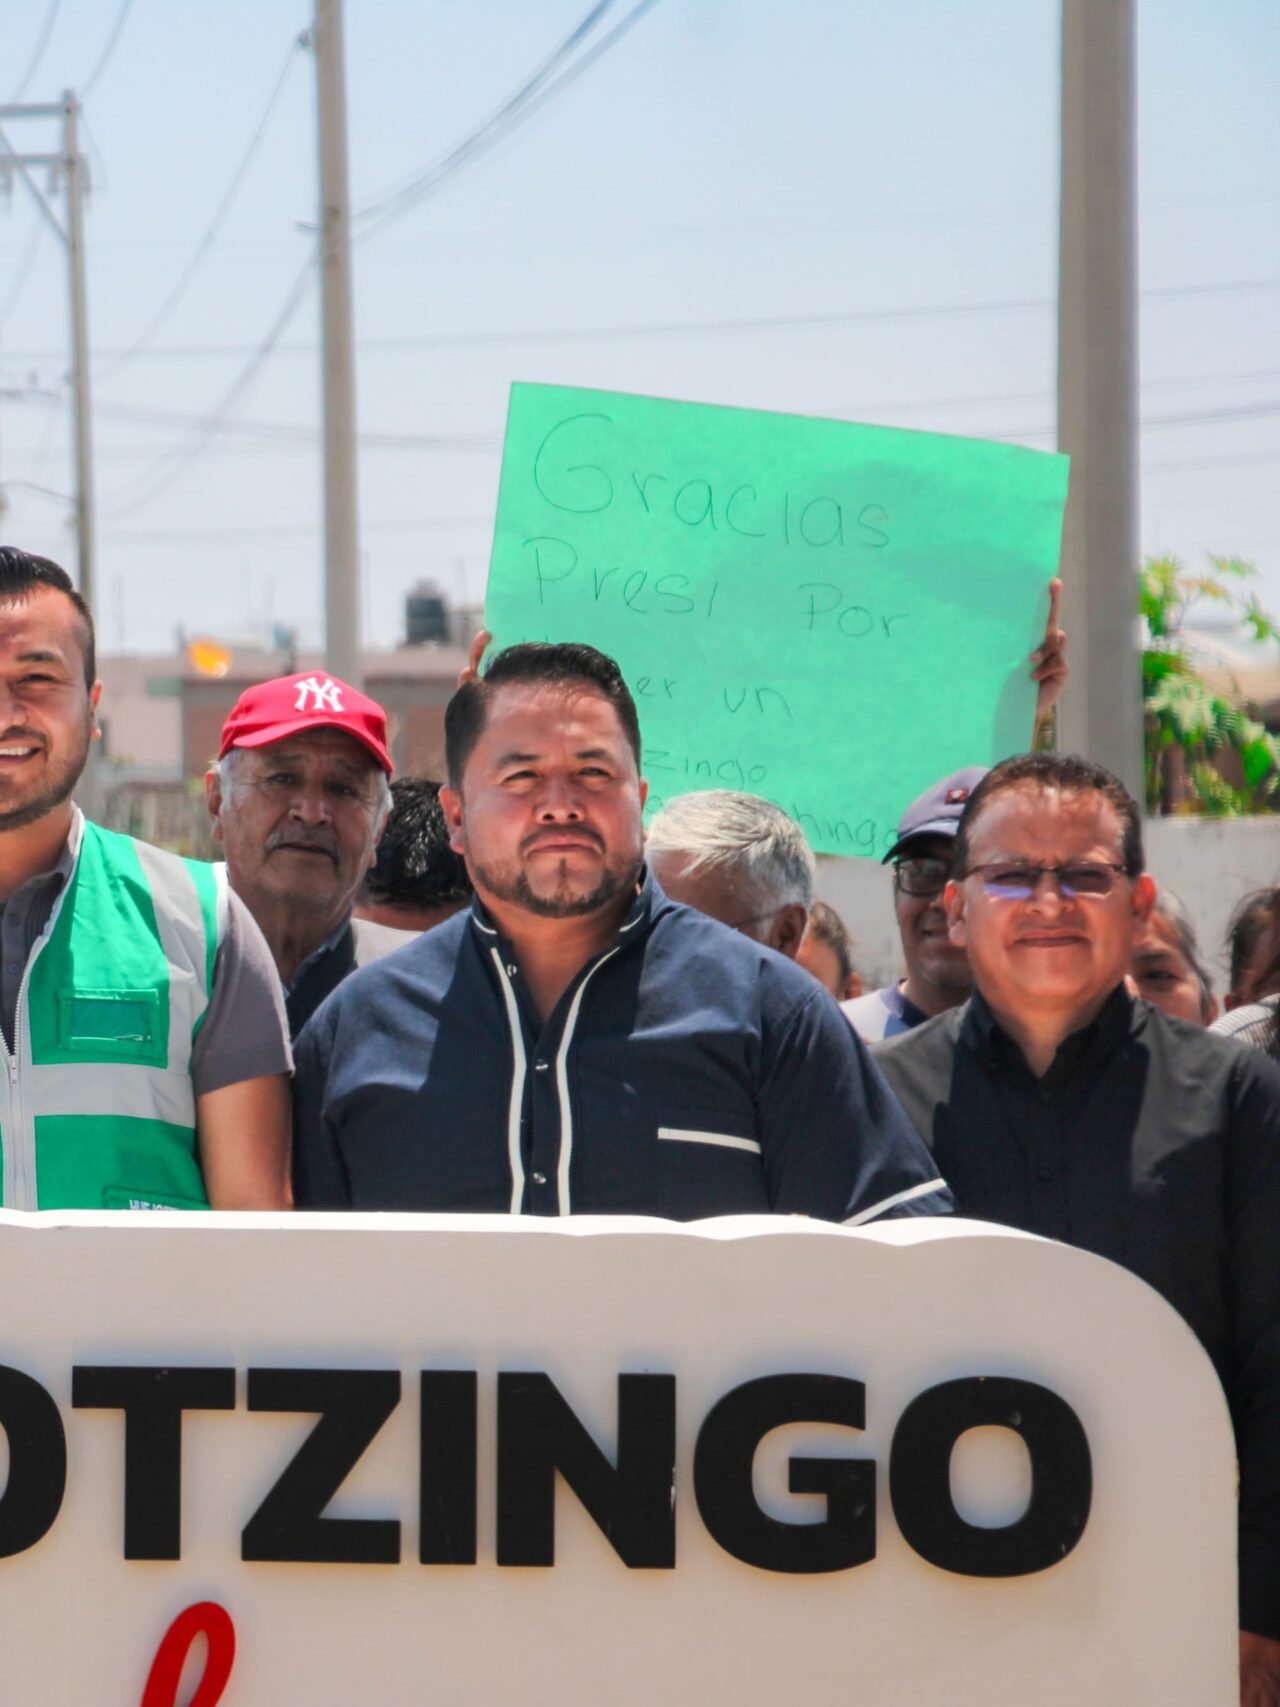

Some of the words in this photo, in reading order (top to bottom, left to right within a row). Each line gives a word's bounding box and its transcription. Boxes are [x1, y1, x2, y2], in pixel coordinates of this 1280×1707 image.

[533, 412, 891, 549] Gracias
[522, 536, 720, 618] Presi
[799, 582, 912, 640] Por
[293, 677, 345, 713] NY
